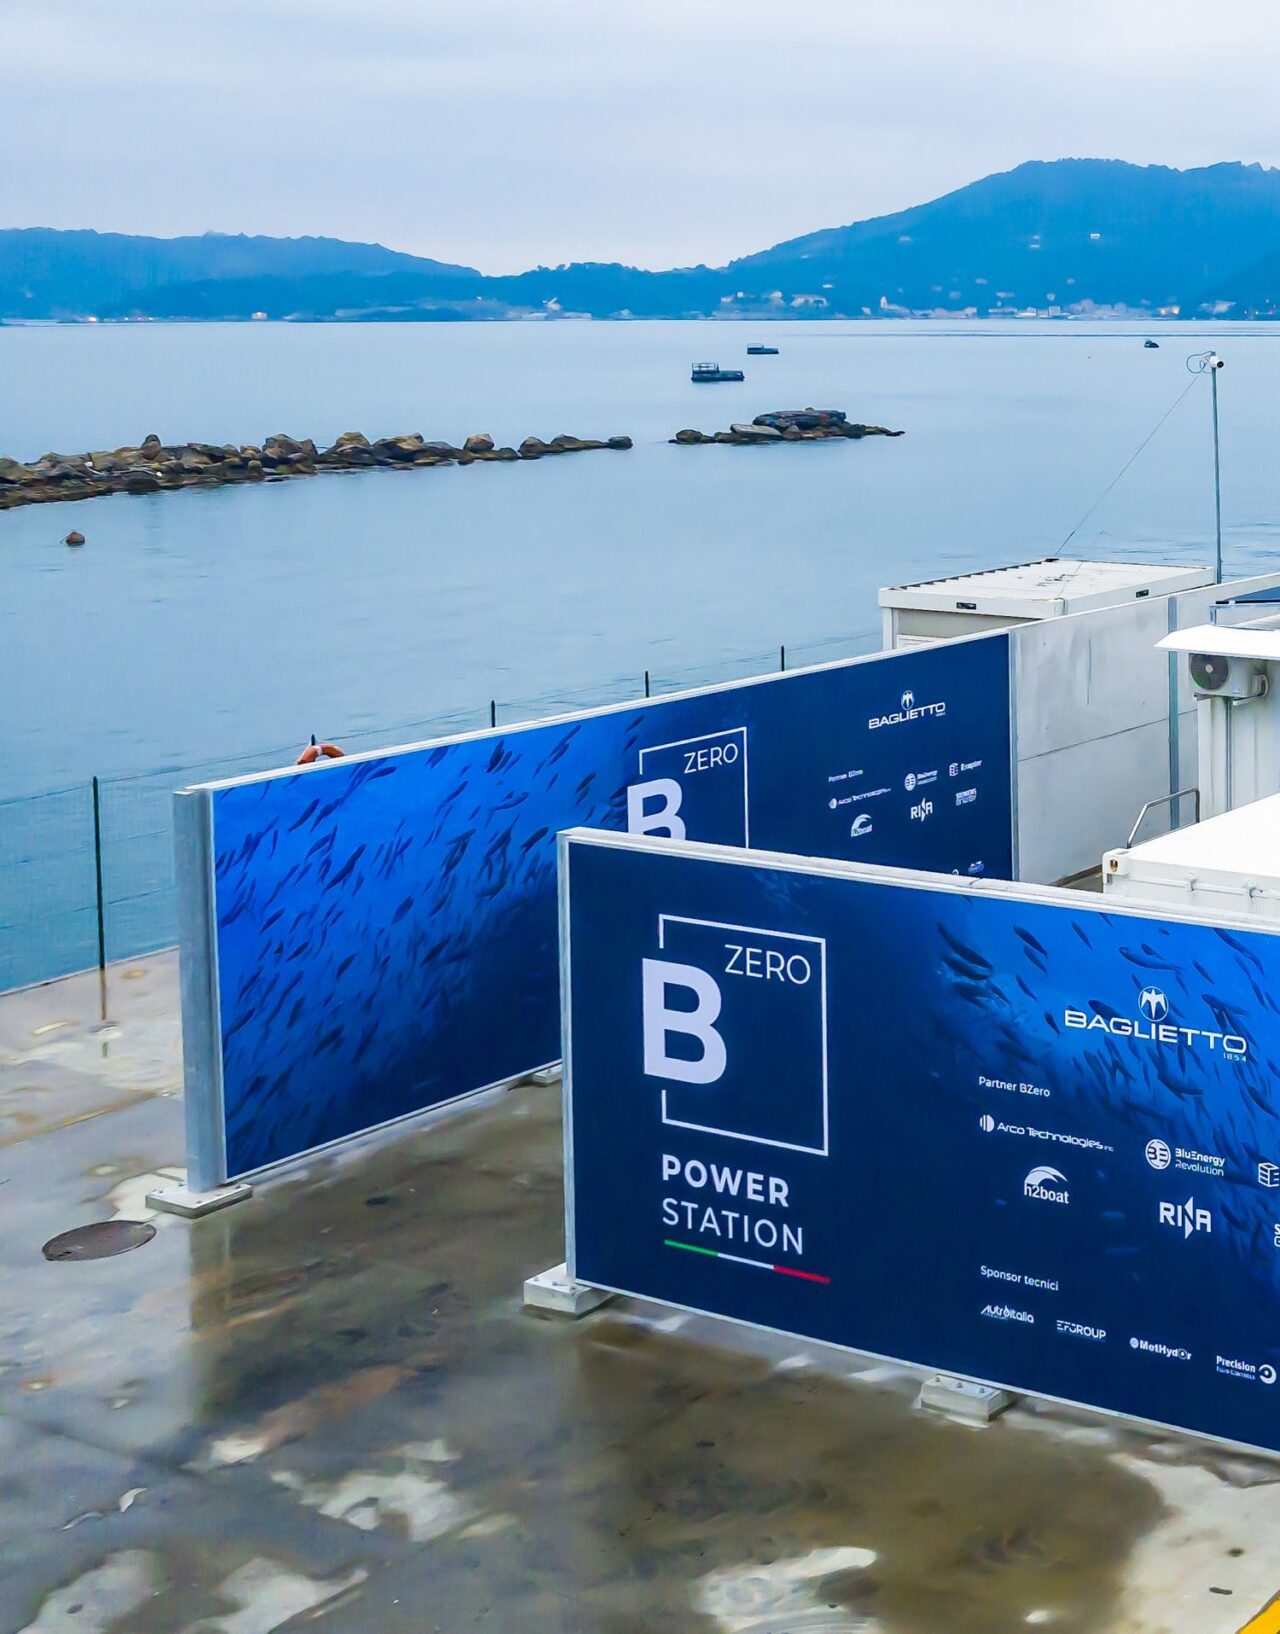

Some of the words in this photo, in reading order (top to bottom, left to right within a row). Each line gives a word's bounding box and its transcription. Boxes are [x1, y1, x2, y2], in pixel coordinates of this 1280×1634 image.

[868, 702, 946, 729] BAGLIETTO
[684, 742, 738, 774] ZERO
[724, 943, 811, 985] ZERO
[642, 957, 728, 1085] B
[1065, 1010, 1247, 1054] BAGLIETTO
[979, 1076, 1017, 1091] Partner
[1019, 1083, 1050, 1097] BZero
[997, 1122, 1025, 1135] Arco
[1027, 1127, 1103, 1149] Technologies
[662, 1154, 790, 1207] POWER
[1175, 1160, 1224, 1177] Revolution
[1024, 1182, 1070, 1204] h2boat
[662, 1198, 804, 1255] STATION
[1159, 1196, 1212, 1240] RINA
[980, 1265, 1022, 1283] Sponsor
[1024, 1275, 1059, 1291] tecnici
[1216, 1355, 1256, 1373] Precision
